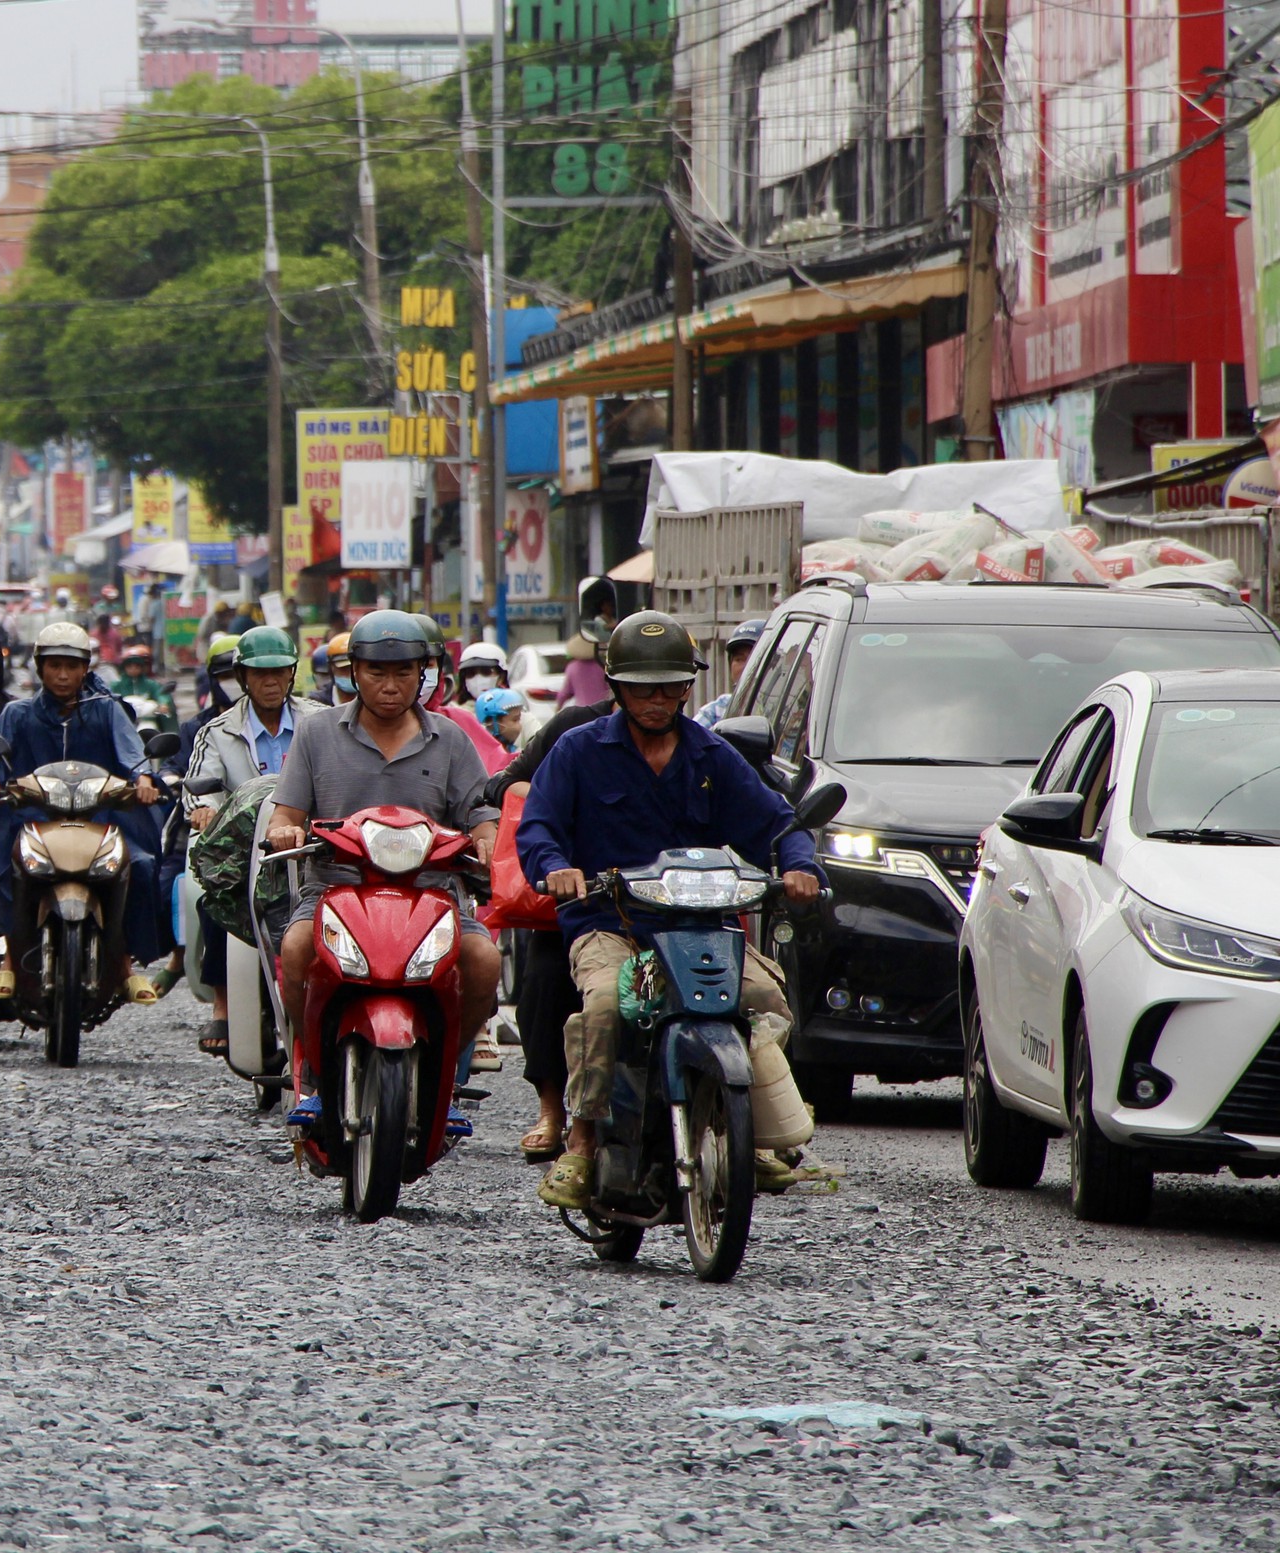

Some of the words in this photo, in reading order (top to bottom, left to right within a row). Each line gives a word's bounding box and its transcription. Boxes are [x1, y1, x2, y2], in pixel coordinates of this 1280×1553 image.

[521, 52, 661, 120] PHÁT
[551, 143, 631, 196] 88
[401, 286, 455, 327] MUA
[347, 465, 406, 532] PHỞ
[348, 541, 378, 561] MINH
[381, 536, 407, 561] ĐỨC
